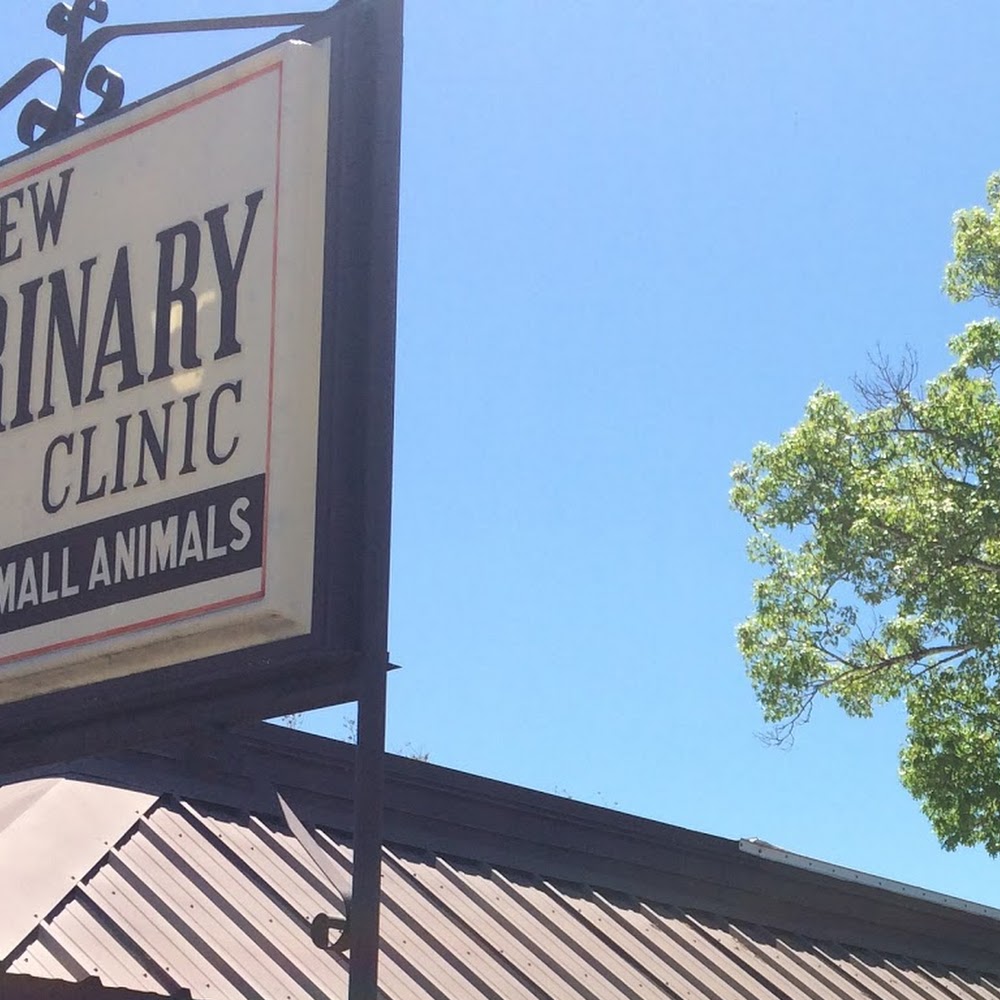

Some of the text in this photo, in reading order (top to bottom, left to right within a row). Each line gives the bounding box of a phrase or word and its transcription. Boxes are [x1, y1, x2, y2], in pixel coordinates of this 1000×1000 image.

[0, 190, 264, 432] INARY
[42, 380, 243, 514] CLINIC
[0, 497, 251, 614] MALL ANIMALS
